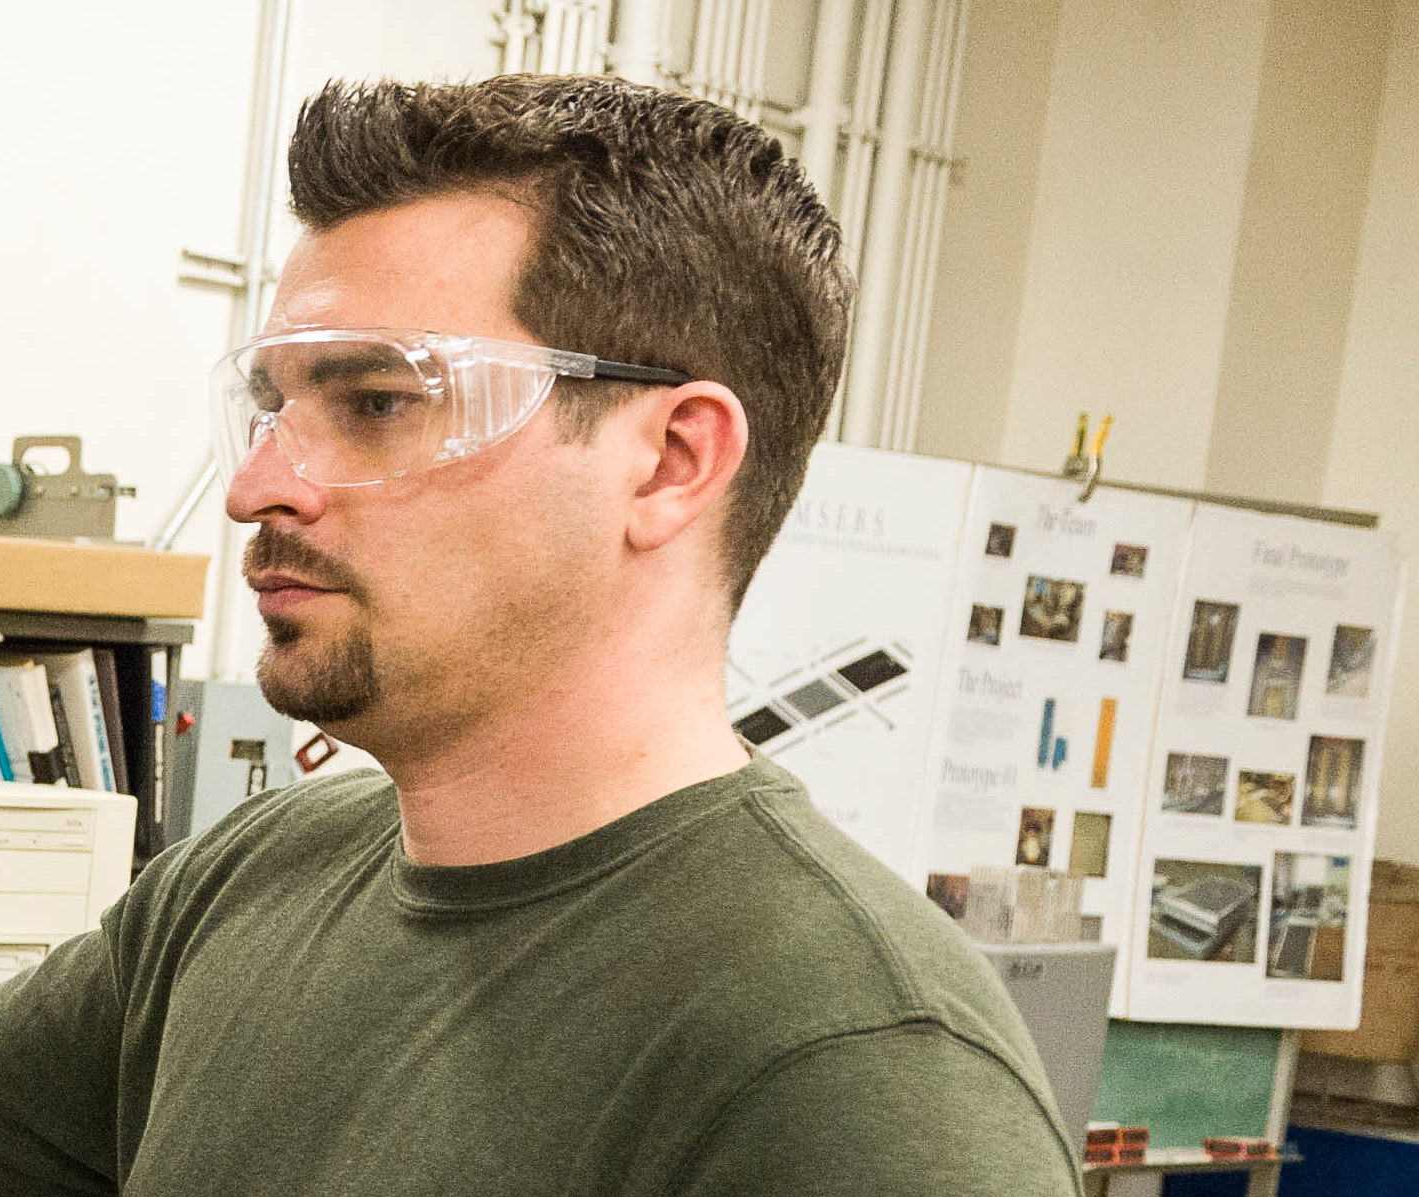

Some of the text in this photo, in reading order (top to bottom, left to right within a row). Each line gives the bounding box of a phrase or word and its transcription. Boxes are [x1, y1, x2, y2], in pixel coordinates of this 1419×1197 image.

[958, 665, 1025, 705] The Project
[941, 755, 999, 795] Prototype
